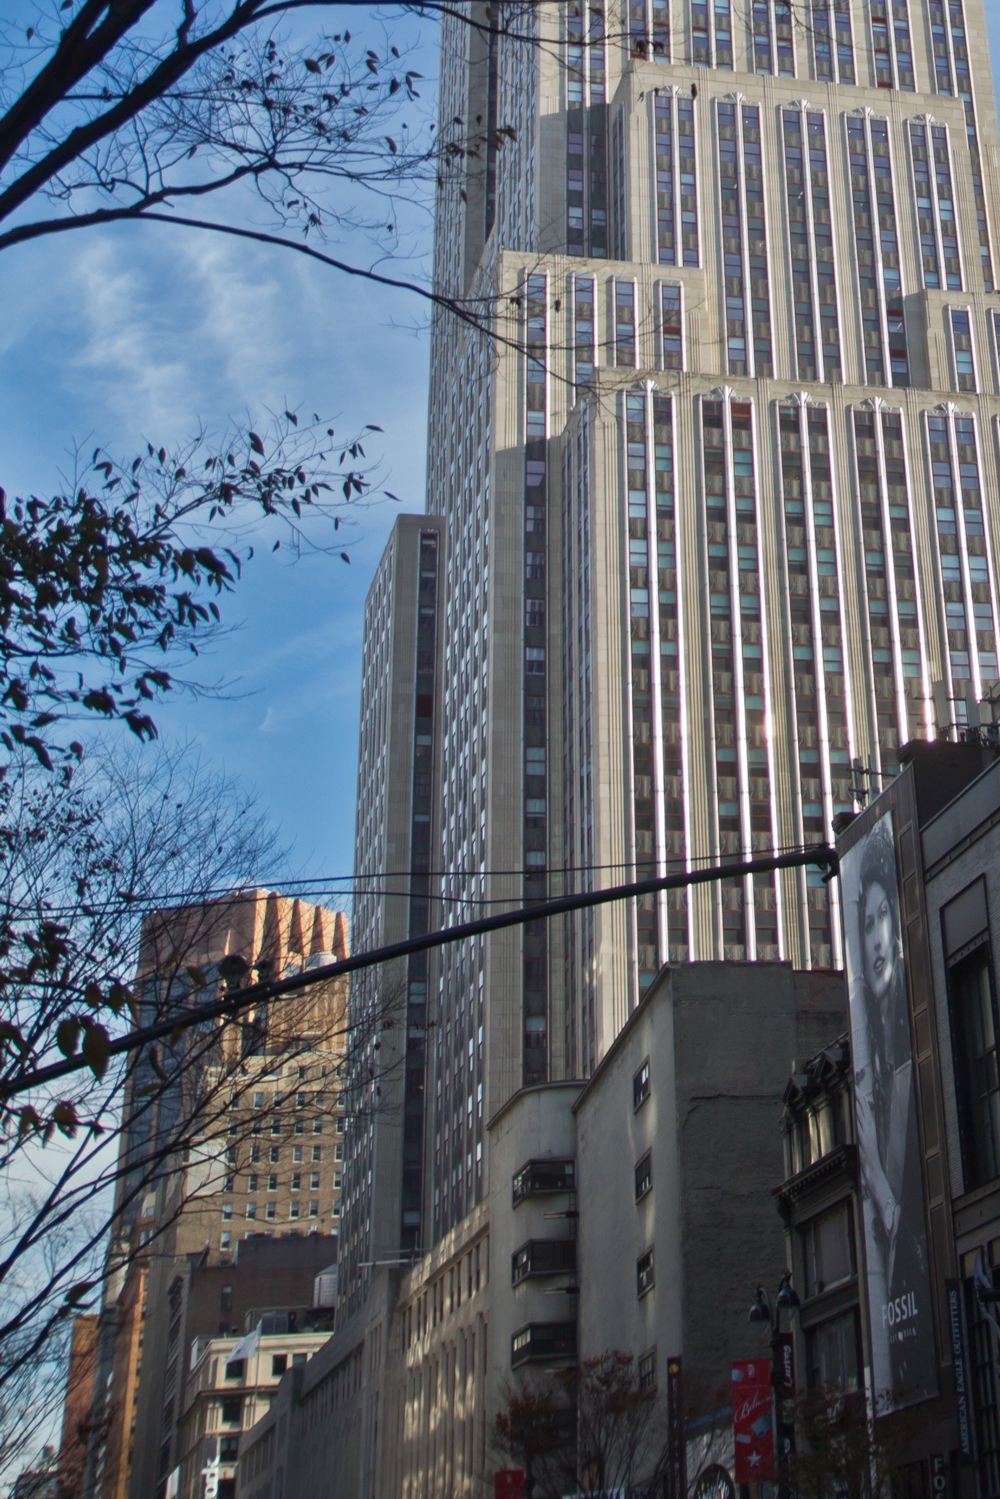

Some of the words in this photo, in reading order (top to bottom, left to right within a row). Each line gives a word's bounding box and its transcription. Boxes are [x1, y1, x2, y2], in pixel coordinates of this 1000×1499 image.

[881, 1290, 919, 1329] FOSSIL
[949, 1290, 962, 1355] OUTFITTERS
[953, 1357, 966, 1393] EAGLE
[957, 1395, 970, 1455] AMERICAN
